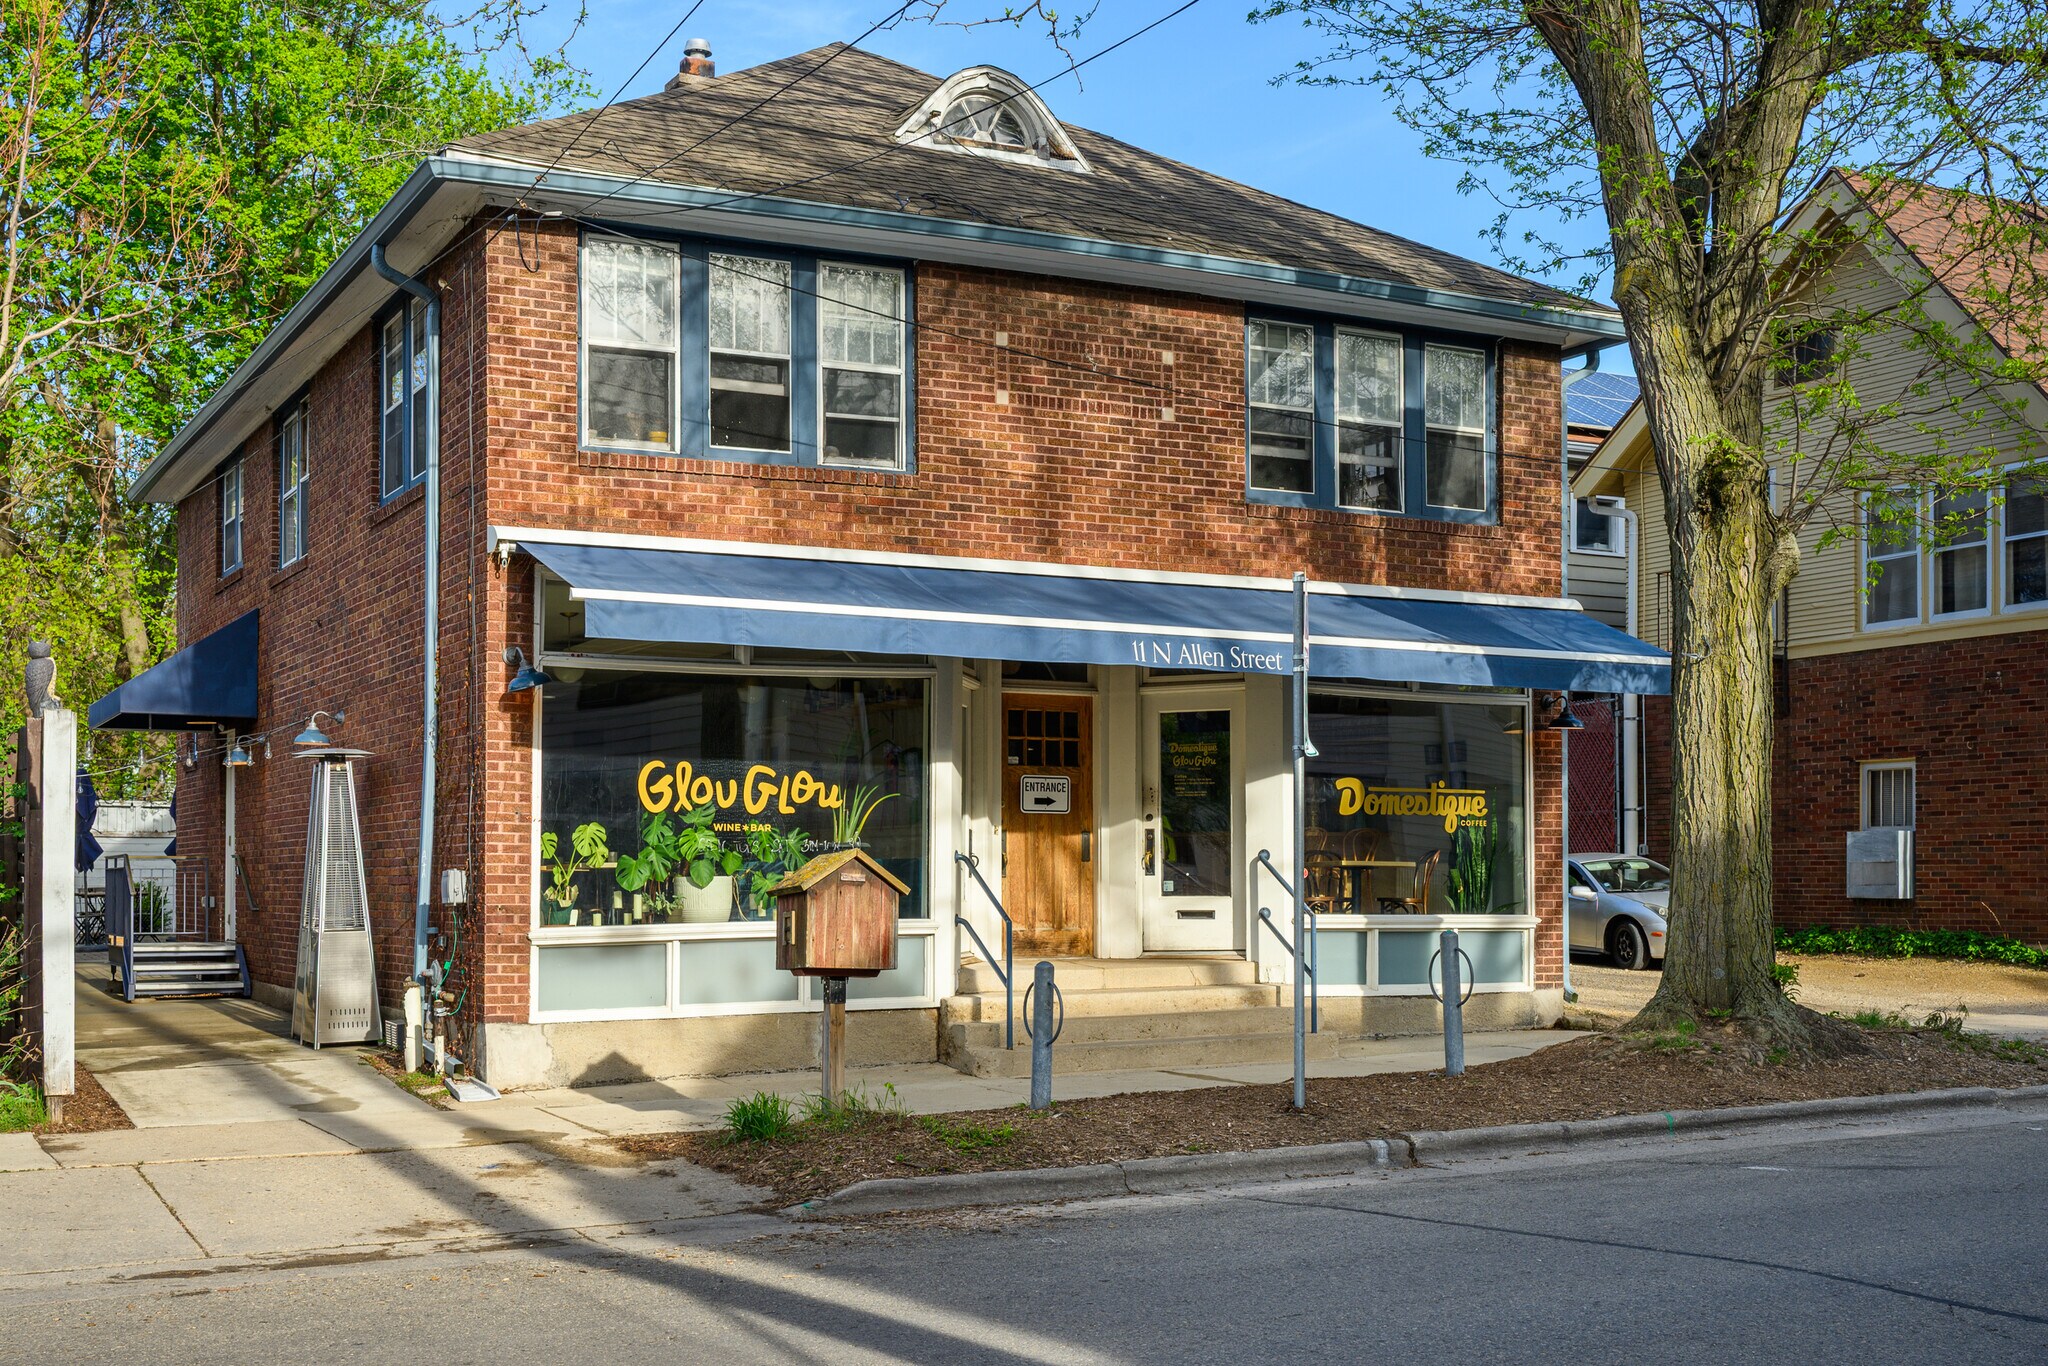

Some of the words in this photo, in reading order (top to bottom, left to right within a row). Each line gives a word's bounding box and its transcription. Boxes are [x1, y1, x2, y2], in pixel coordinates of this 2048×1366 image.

[1132, 640, 1147, 663] 11
[1153, 641, 1171, 665] N
[1178, 643, 1225, 668] Allen
[1230, 646, 1284, 671] Street
[638, 760, 738, 814] Glou
[1025, 781, 1067, 793] ENTRANCE
[1335, 776, 1489, 834] Domestique
[713, 823, 741, 832] WINE
[750, 823, 772, 832] BAR
